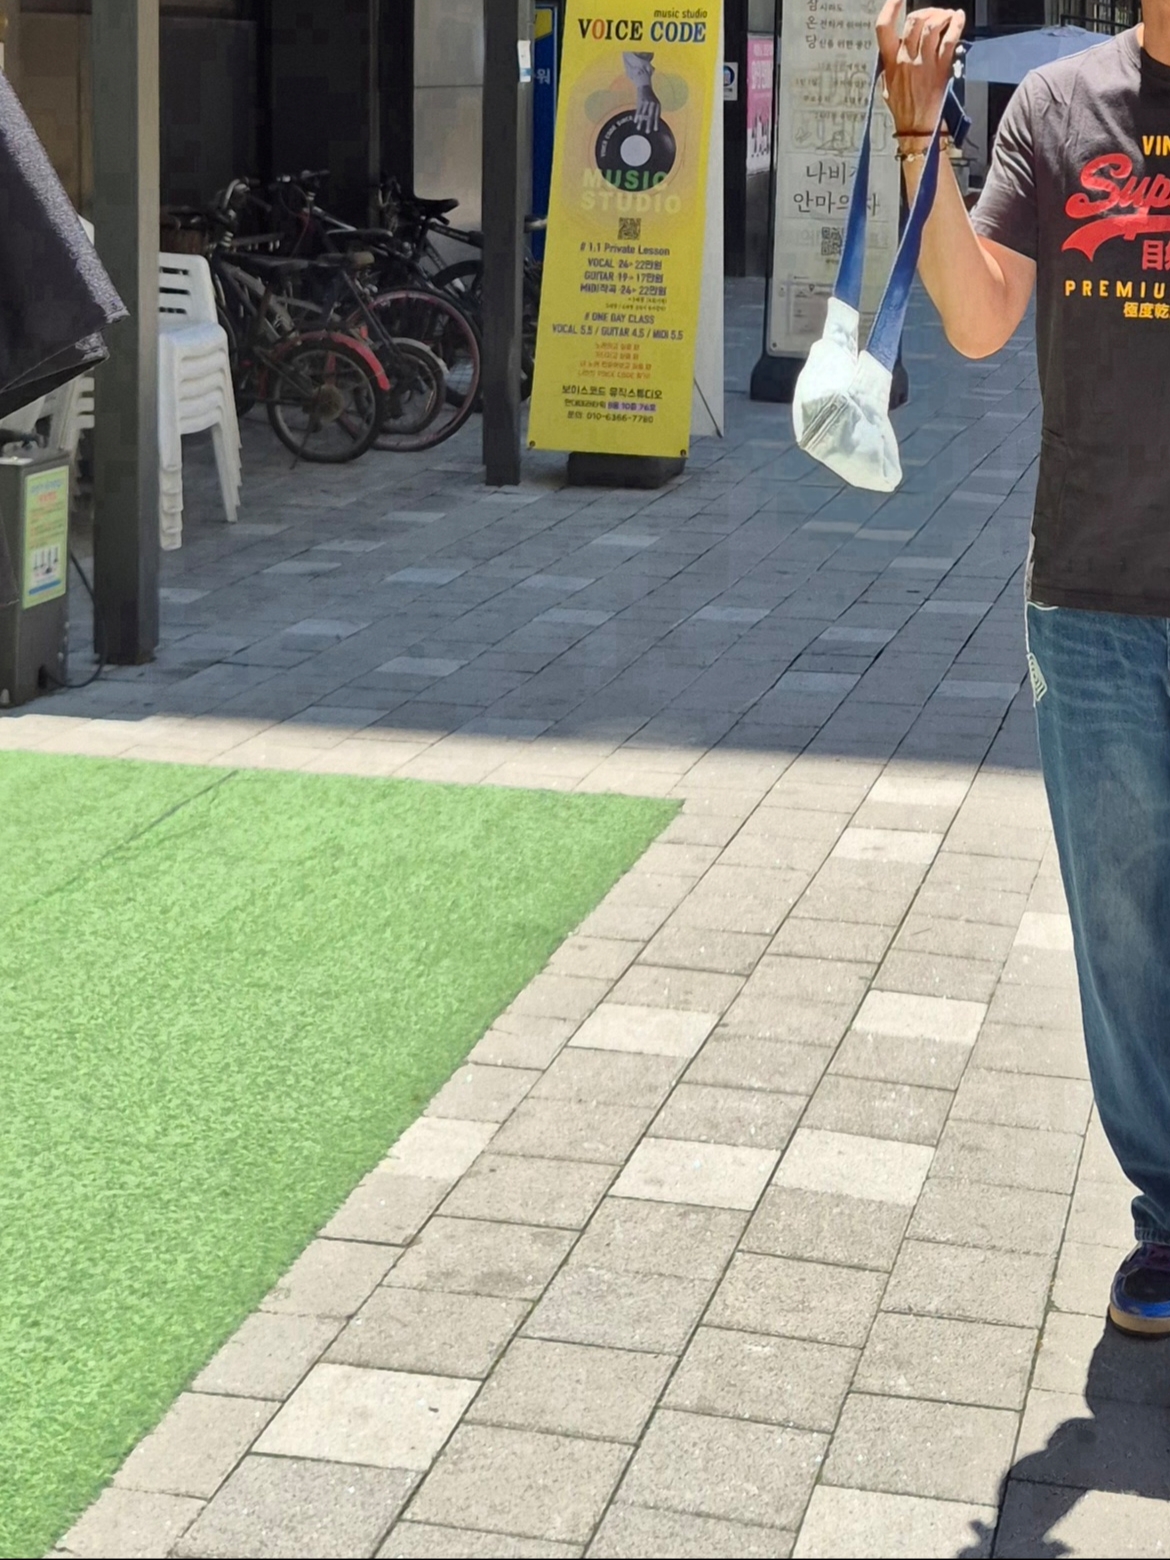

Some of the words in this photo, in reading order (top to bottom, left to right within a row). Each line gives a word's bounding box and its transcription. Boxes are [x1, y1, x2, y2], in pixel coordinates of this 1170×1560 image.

[654, 9, 680, 19] music
[682, 7, 708, 19] studio
[578, 18, 643, 41] VOICE
[650, 21, 706, 43] CODE
[583, 168, 669, 190] MUSIC
[604, 243, 635, 254] Private
[638, 245, 670, 256] Lesson
[588, 258, 614, 269] VOCAL
[584, 270, 614, 281] GUITAR
[592, 312, 608, 322] ONE
[611, 313, 626, 323] DAY
[628, 314, 655, 324] CLASS
[552, 324, 577, 334] VOCAL
[601, 326, 629, 337] GUITAR
[652, 329, 669, 339] MIDI
[562, 385, 606, 396] 보이스코드
[609, 387, 663, 399] 뮤직스튜디오
